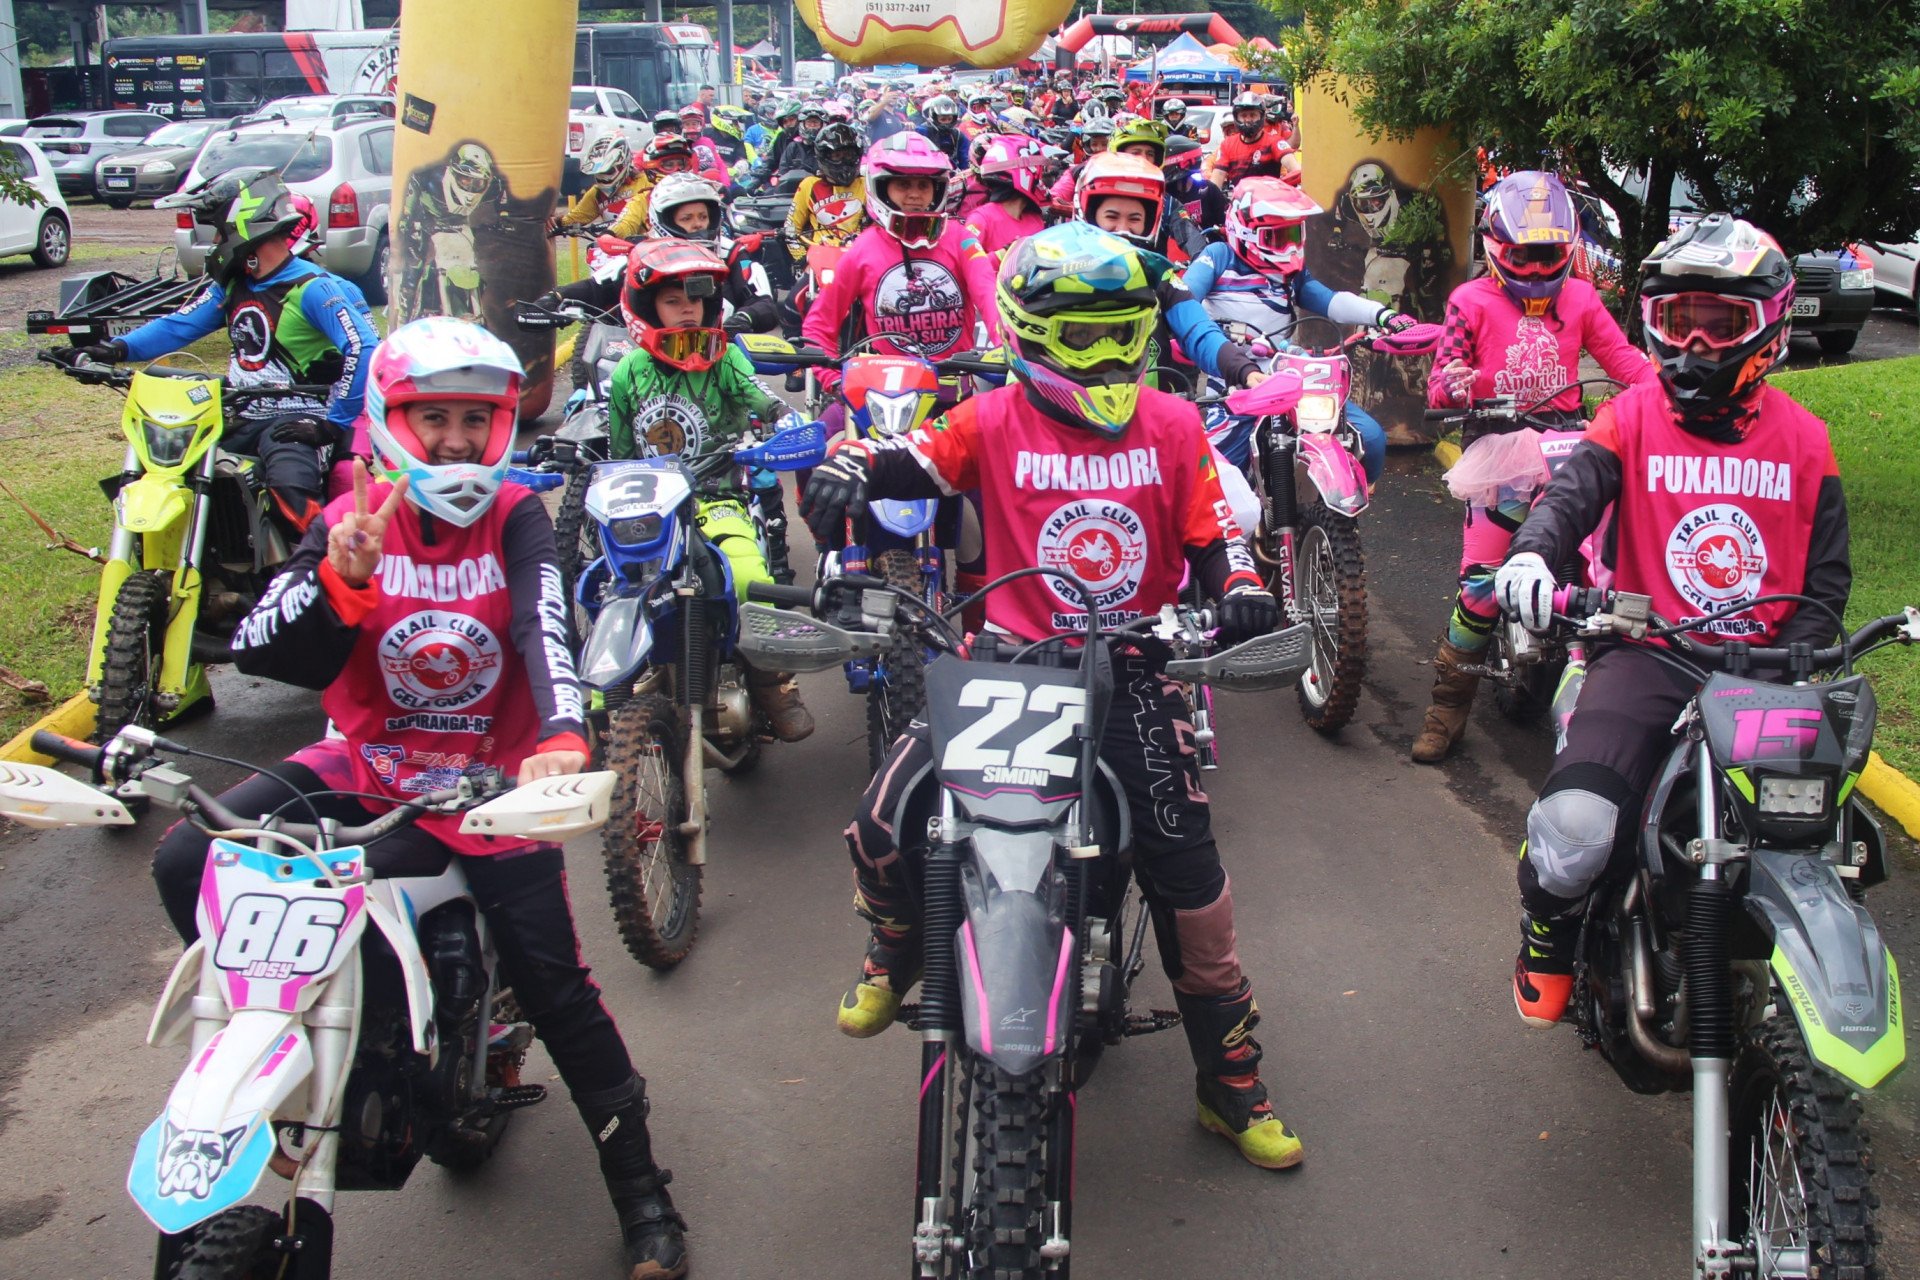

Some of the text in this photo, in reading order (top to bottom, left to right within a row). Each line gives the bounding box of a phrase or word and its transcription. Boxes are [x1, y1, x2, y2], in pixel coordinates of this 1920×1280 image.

[865, 2, 931, 13] (51) 3377-2417
[1517, 228, 1571, 244] LEATT
[874, 308, 967, 333] TRILHEIRAS
[921, 331, 948, 344] SUL
[882, 366, 904, 391] 1
[1302, 362, 1332, 391] 2
[612, 463, 652, 473] HONDA
[1014, 446, 1163, 491] PUXADORA
[1647, 454, 1791, 502] PUXADORA
[606, 473, 660, 511] 3
[1046, 504, 1139, 540] TRAIL CLUB
[1675, 508, 1759, 547] TRAIL CLUB
[1052, 578, 1138, 607] GELA GUELA
[1278, 544, 1296, 612] GILVAN
[386, 614, 489, 650] TRAIL CLUB
[392, 682, 488, 708] GELA GUELA
[386, 713, 493, 734] SAPIRANGA-RS
[940, 678, 1088, 778] 22
[1729, 708, 1824, 763] 15
[981, 764, 1051, 787] SIMONI
[214, 892, 348, 976] 86
[241, 959, 295, 980] JOSY
[1787, 974, 1821, 1028] DUNLOP
[1889, 973, 1899, 1028] DUNLOP
[1840, 1025, 1878, 1034] Honda
